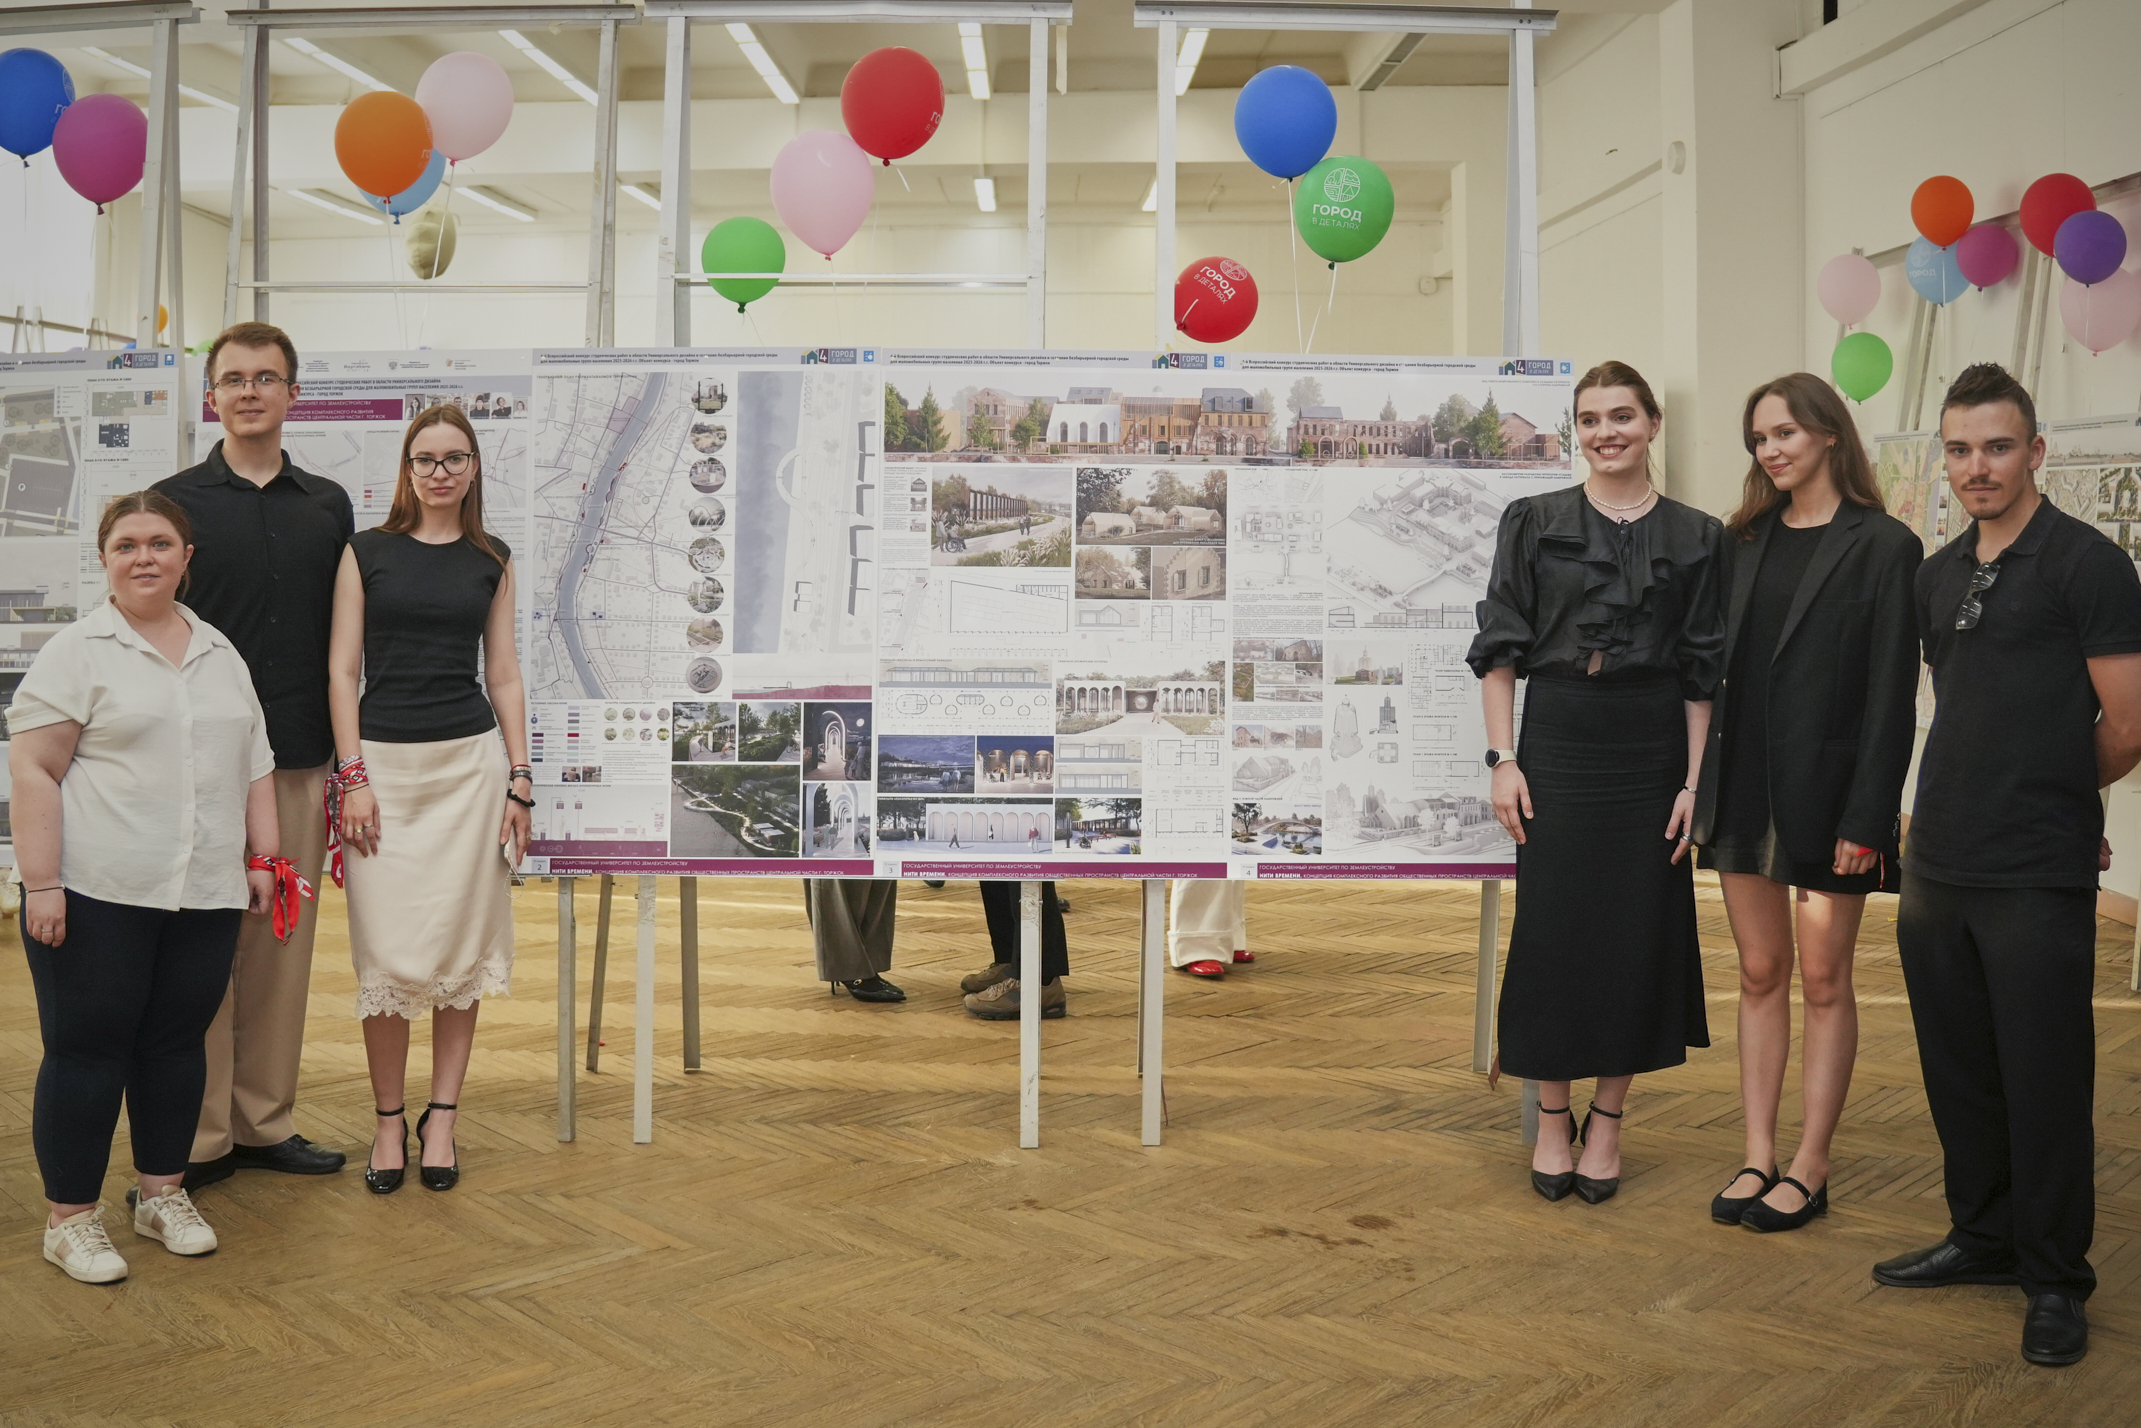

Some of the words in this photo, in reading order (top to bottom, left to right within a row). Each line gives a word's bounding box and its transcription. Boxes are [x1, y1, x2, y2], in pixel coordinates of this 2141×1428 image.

[1312, 204, 1362, 223] ГОРОД
[1319, 218, 1360, 230] ДЕТАЛЯХ
[1909, 269, 1936, 278] ГОРОД
[1200, 266, 1236, 300] ГОРОД
[1198, 276, 1228, 304] ДЕТАЛЯХ
[124, 355, 131, 366] 4
[820, 350, 827, 361] 4
[1171, 354, 1178, 366] 4
[1517, 361, 1524, 372] 4
